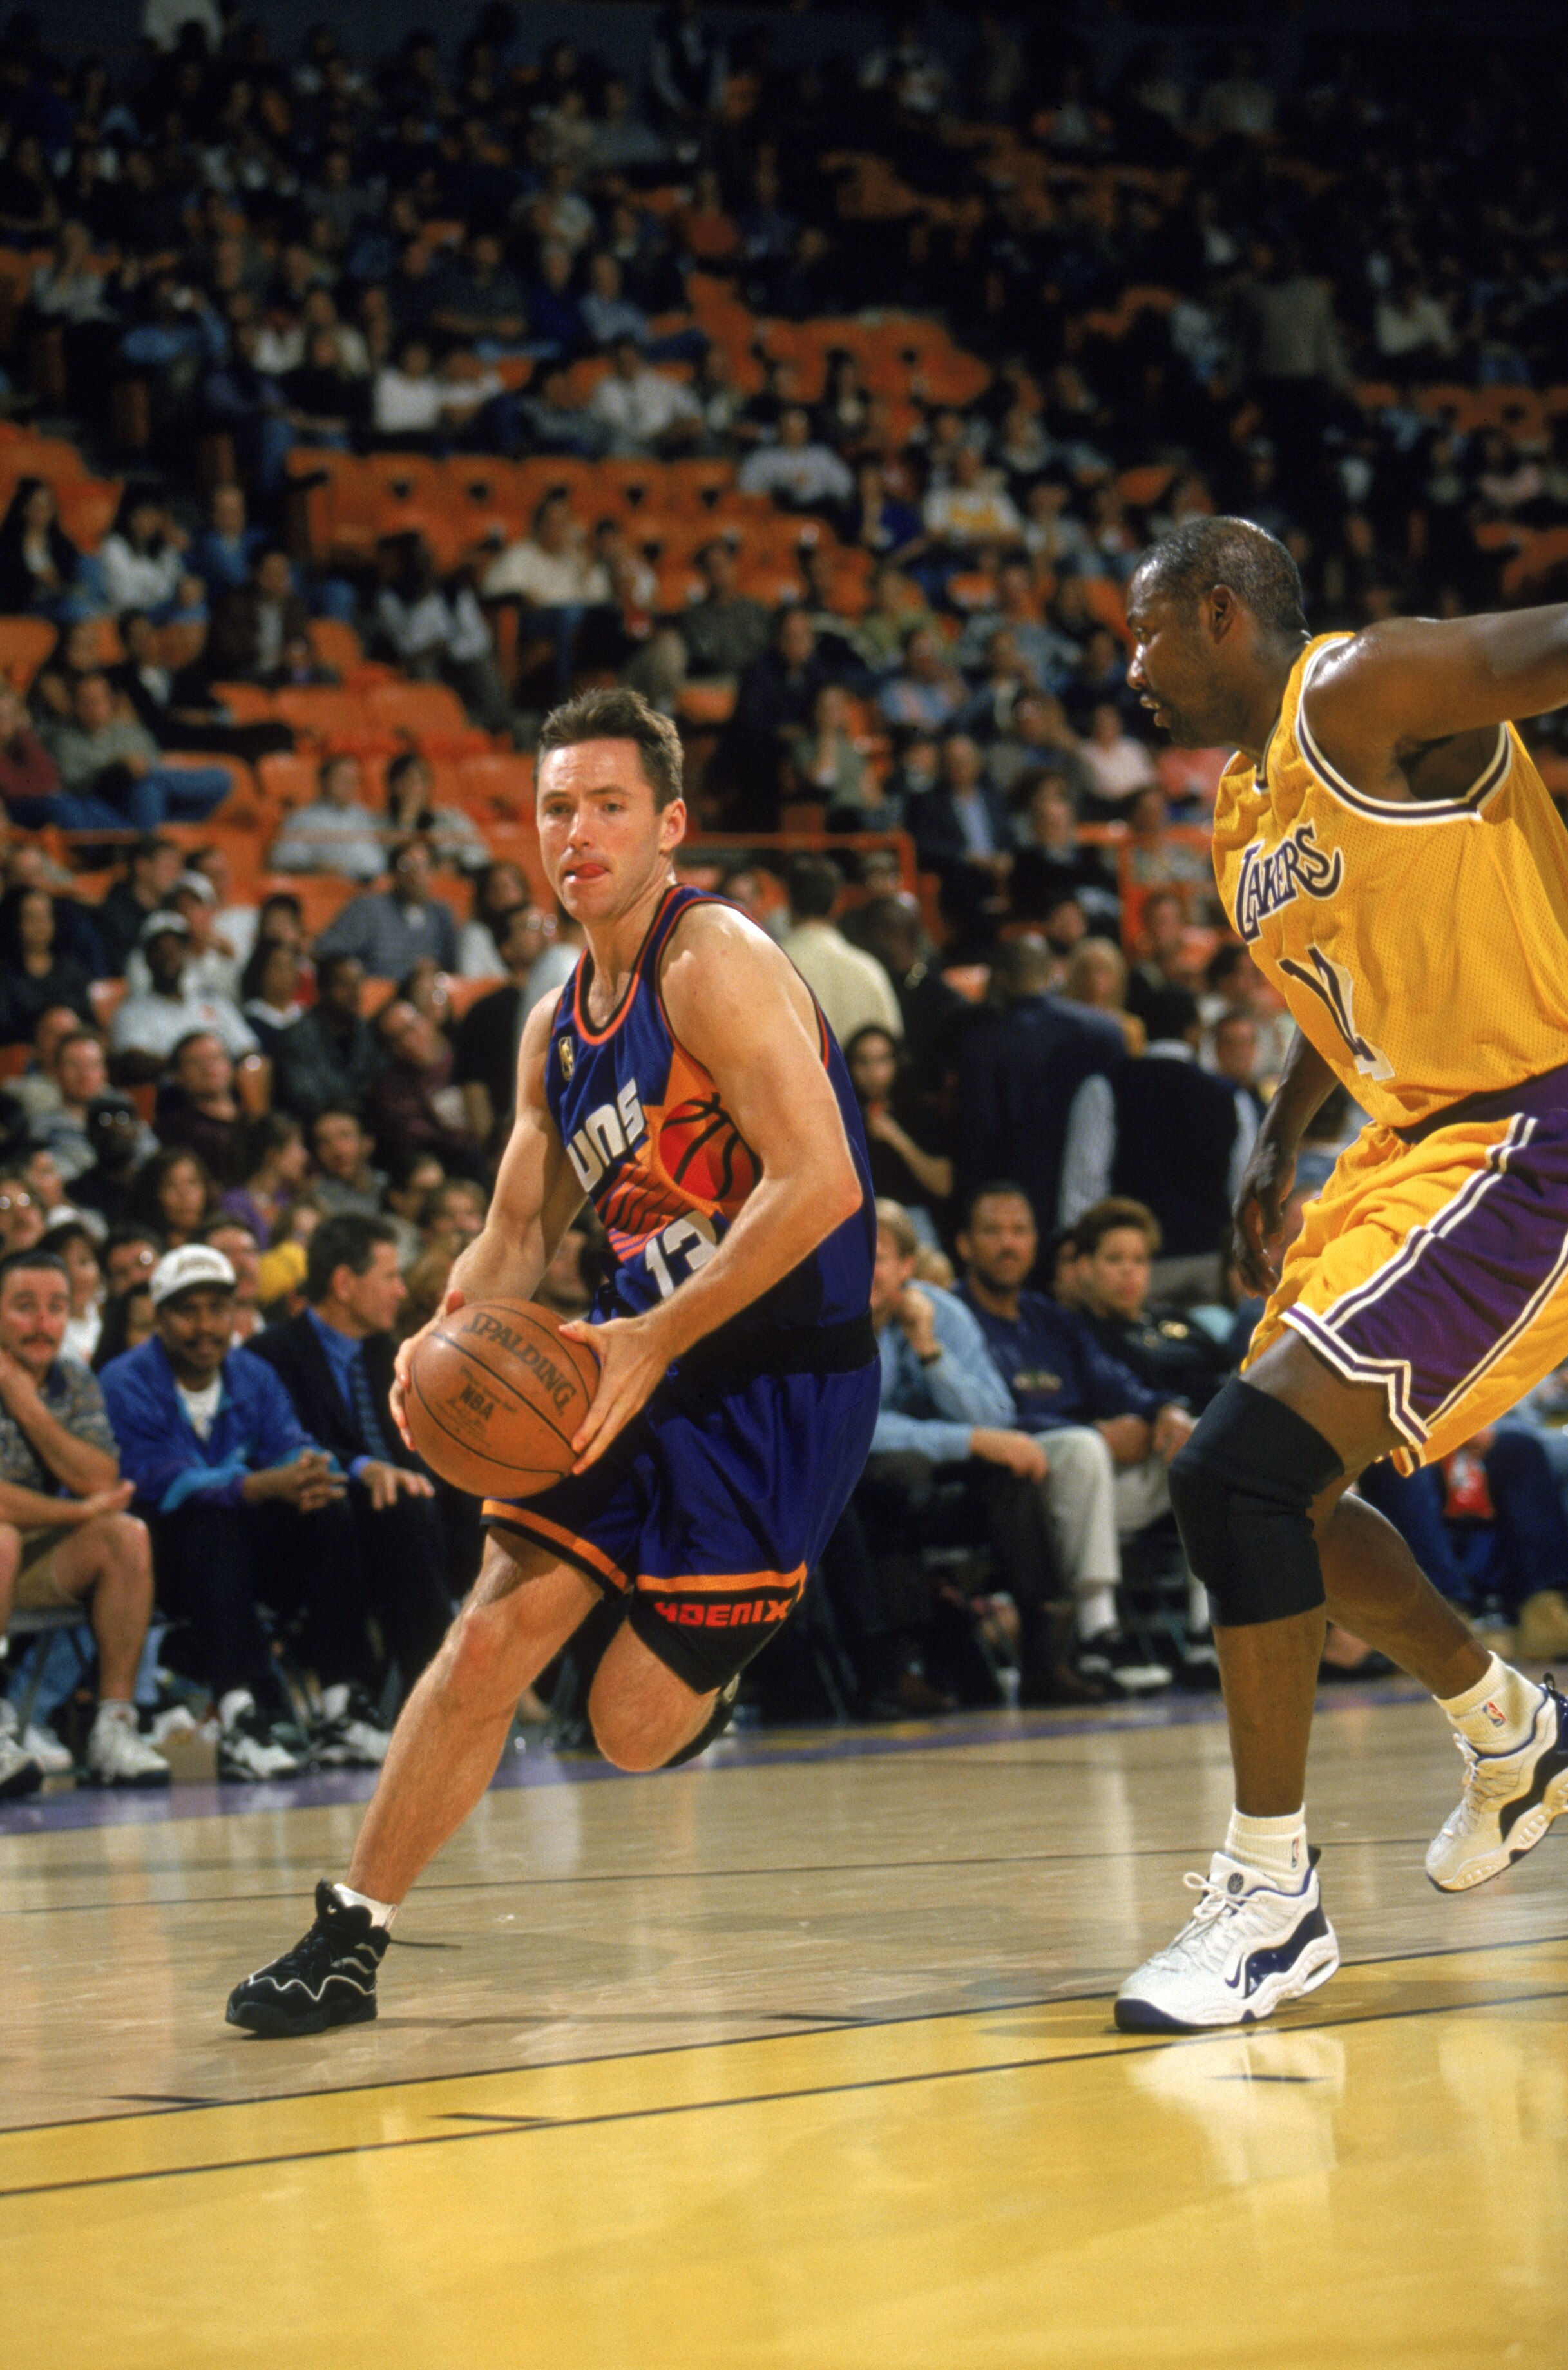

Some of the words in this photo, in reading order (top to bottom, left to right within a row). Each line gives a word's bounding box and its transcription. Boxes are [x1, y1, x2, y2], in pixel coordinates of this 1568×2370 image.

[1235, 818, 1344, 945] LAKERS
[566, 1077, 645, 1193] UNS
[459, 1383, 495, 1420] NBA
[461, 1312, 577, 1416] SPALDING
[653, 1598, 792, 1628] HOENIX
